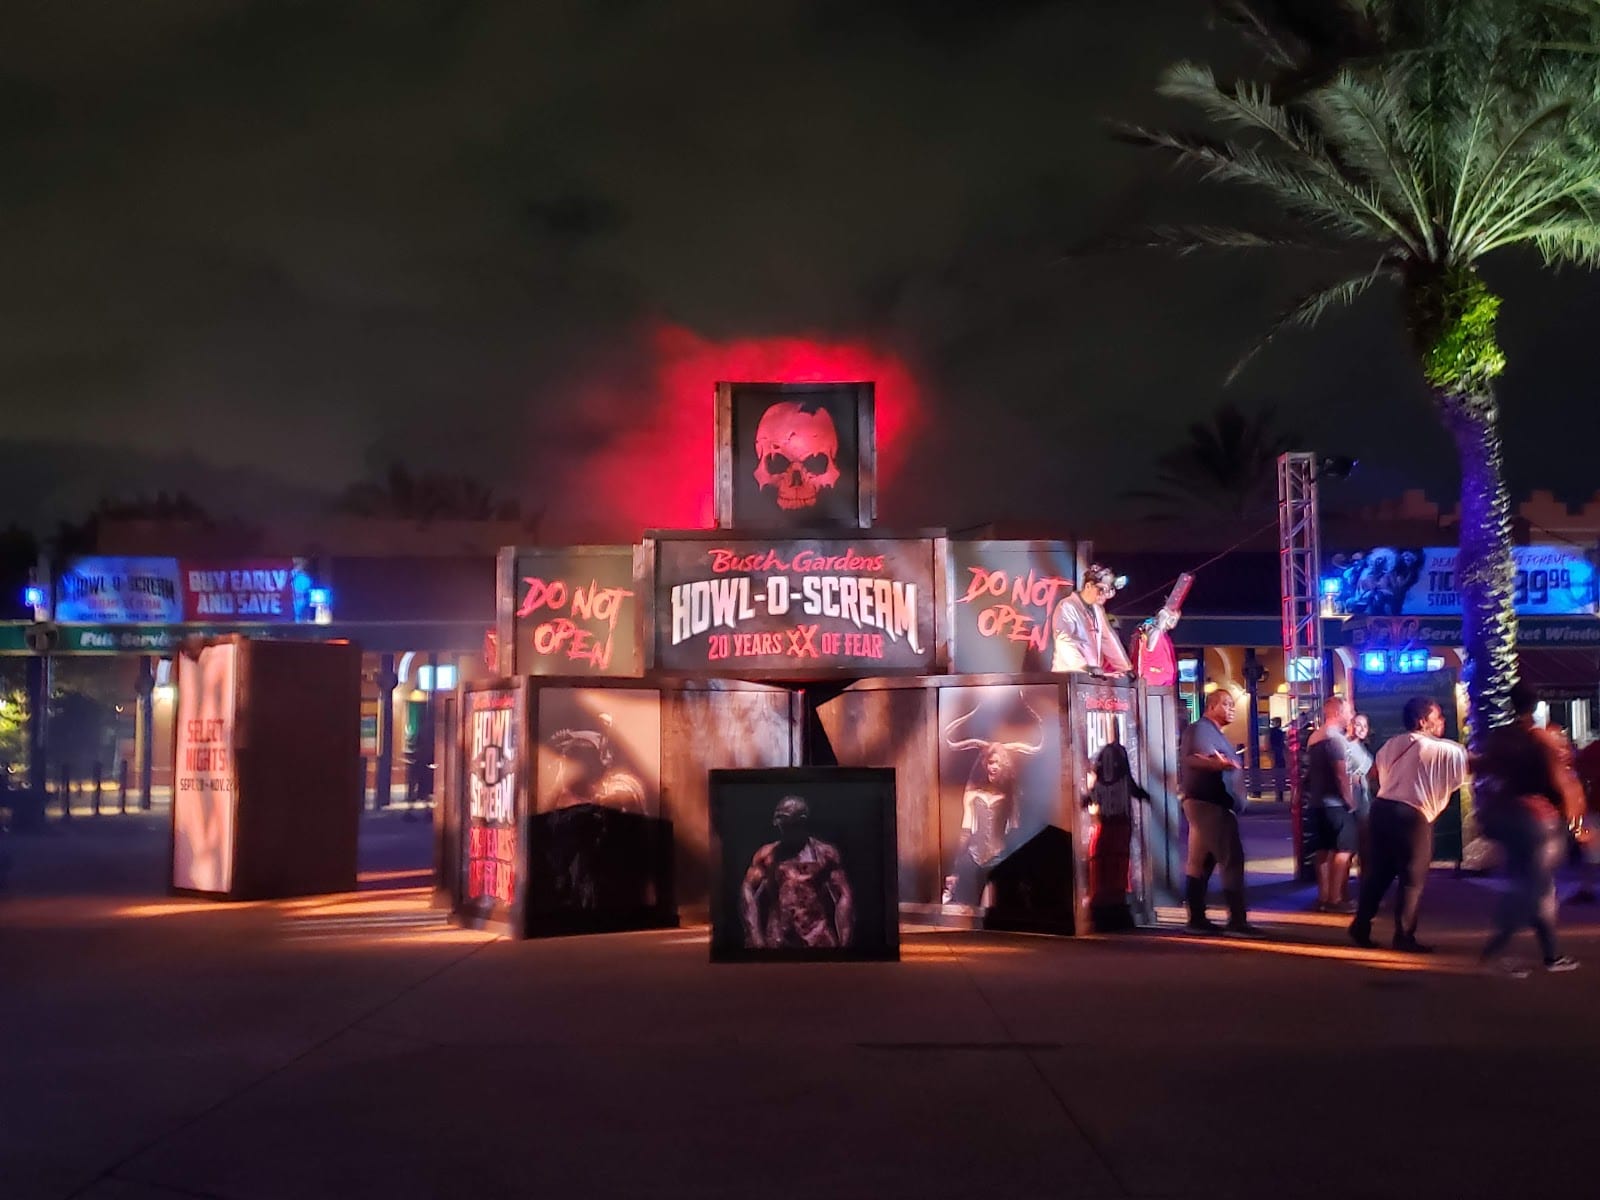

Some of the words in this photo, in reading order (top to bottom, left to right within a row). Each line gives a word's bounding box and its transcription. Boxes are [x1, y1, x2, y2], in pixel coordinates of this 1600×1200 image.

[708, 549, 789, 573] Busch
[792, 548, 885, 573] Gardens
[188, 570, 227, 592] BUY
[230, 569, 287, 592] EARLY
[955, 567, 1008, 603] DO
[1011, 567, 1073, 616] NOT
[197, 593, 235, 615] AND
[237, 593, 281, 615] SAVE
[516, 576, 568, 618] DO
[570, 577, 634, 624] NOT
[671, 575, 924, 655] HOWL-O-SCREAM
[976, 603, 1050, 654] OPEN
[533, 617, 616, 670] OPEN
[708, 635, 730, 660] 20
[732, 631, 783, 657] YEARS
[821, 633, 841, 656] OF
[845, 632, 884, 659] FEAR
[1419, 626, 1462, 641] Serv
[1544, 625, 1600, 641] Windo
[187, 718, 225, 743] SELECT
[472, 709, 513, 761] HOWL
[186, 748, 226, 772] NIGHTS
